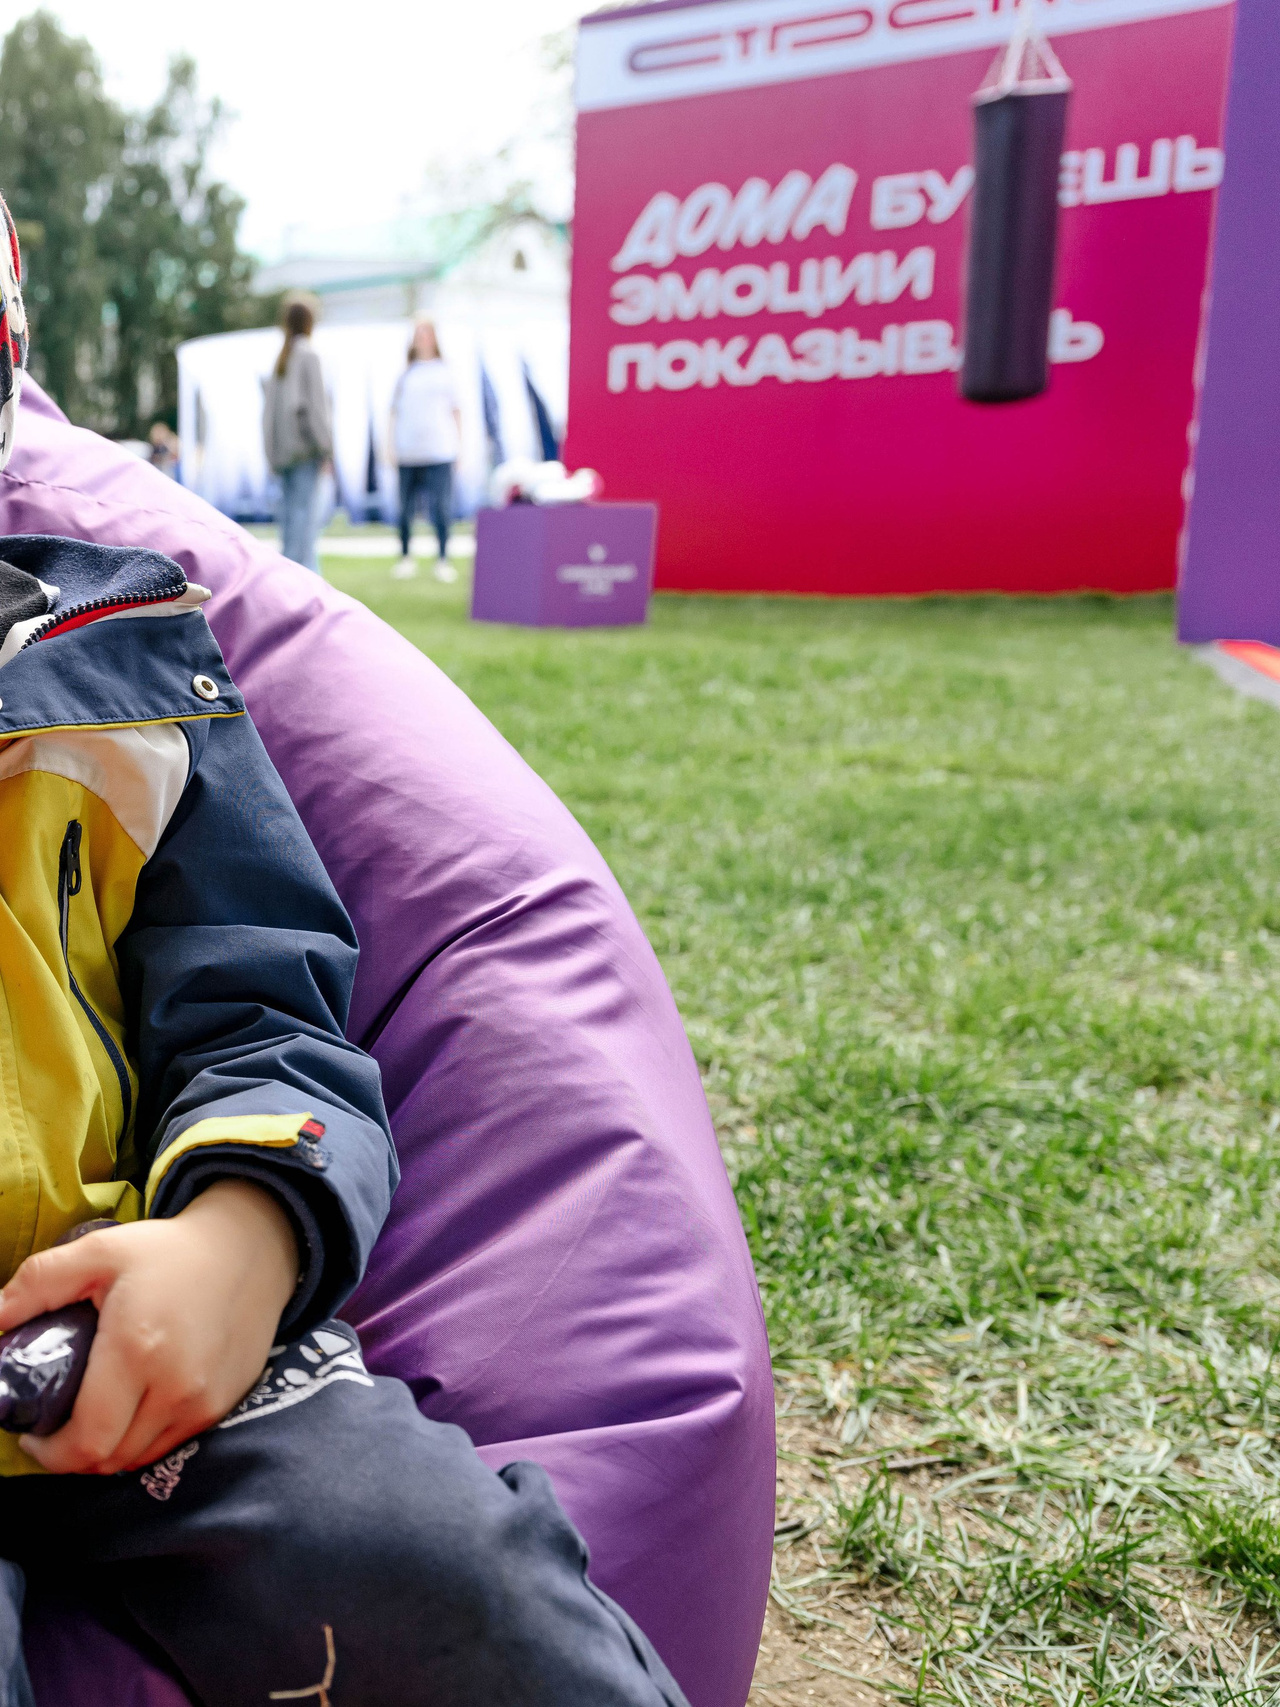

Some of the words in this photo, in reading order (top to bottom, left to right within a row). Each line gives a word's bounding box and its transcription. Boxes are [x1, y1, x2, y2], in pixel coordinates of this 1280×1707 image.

[610, 163, 857, 271] ДОМА
[870, 135, 1225, 230] БУШЬ
[610, 246, 935, 325] ЭМОЦИИ
[608, 308, 1104, 392] ПОКАЗЫВЬ
